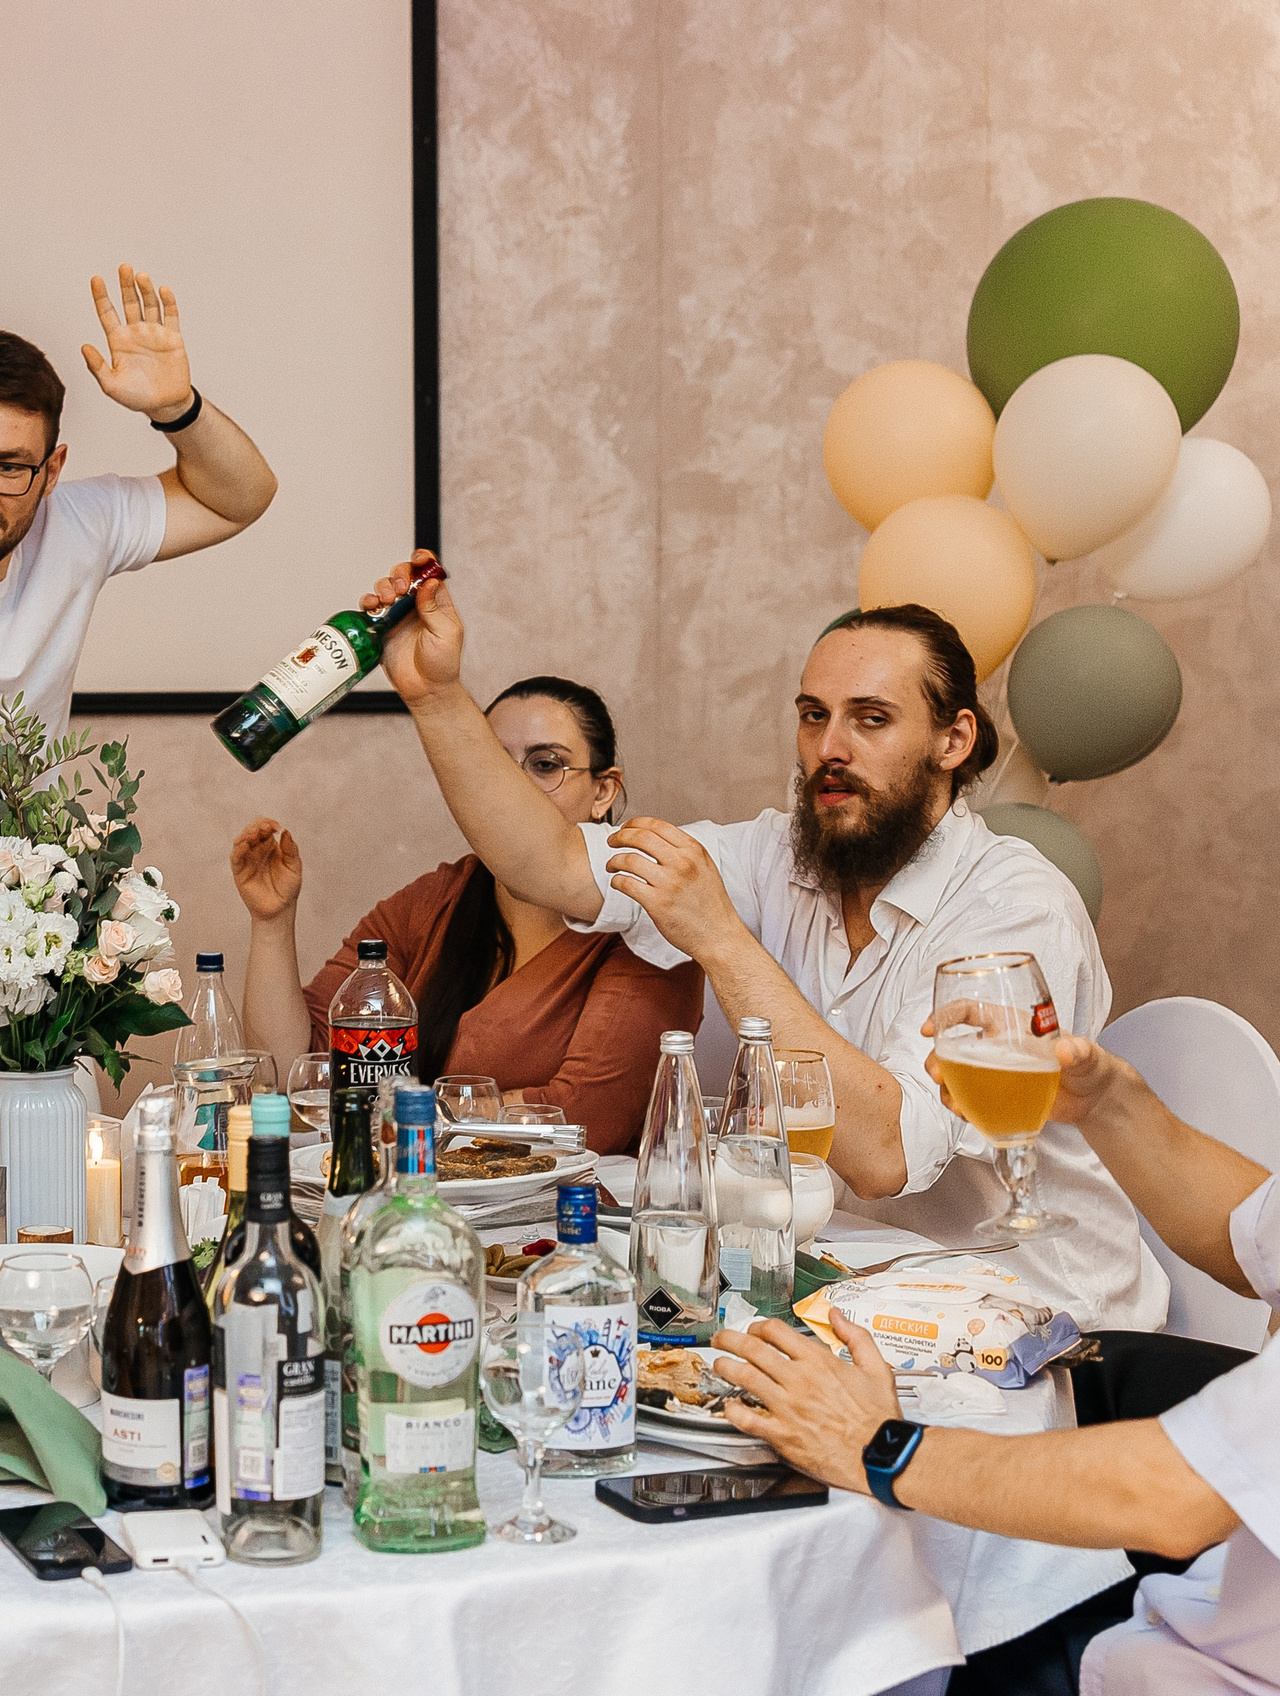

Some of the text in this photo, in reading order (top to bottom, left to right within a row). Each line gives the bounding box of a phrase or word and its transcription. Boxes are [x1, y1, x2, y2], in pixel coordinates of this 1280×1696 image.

[350, 1061, 411, 1084] EVERVESS
[649, 1305, 672, 1313] RIOBA
[391, 1321, 472, 1344] MARTINI
[879, 1317, 930, 1335] ДЕТСКИЕ
[873, 1332, 937, 1348] ВЛАЖНЫЕ САЛФЕТКИ
[981, 1353, 1003, 1366] 100
[113, 1428, 141, 1441] ASTI
